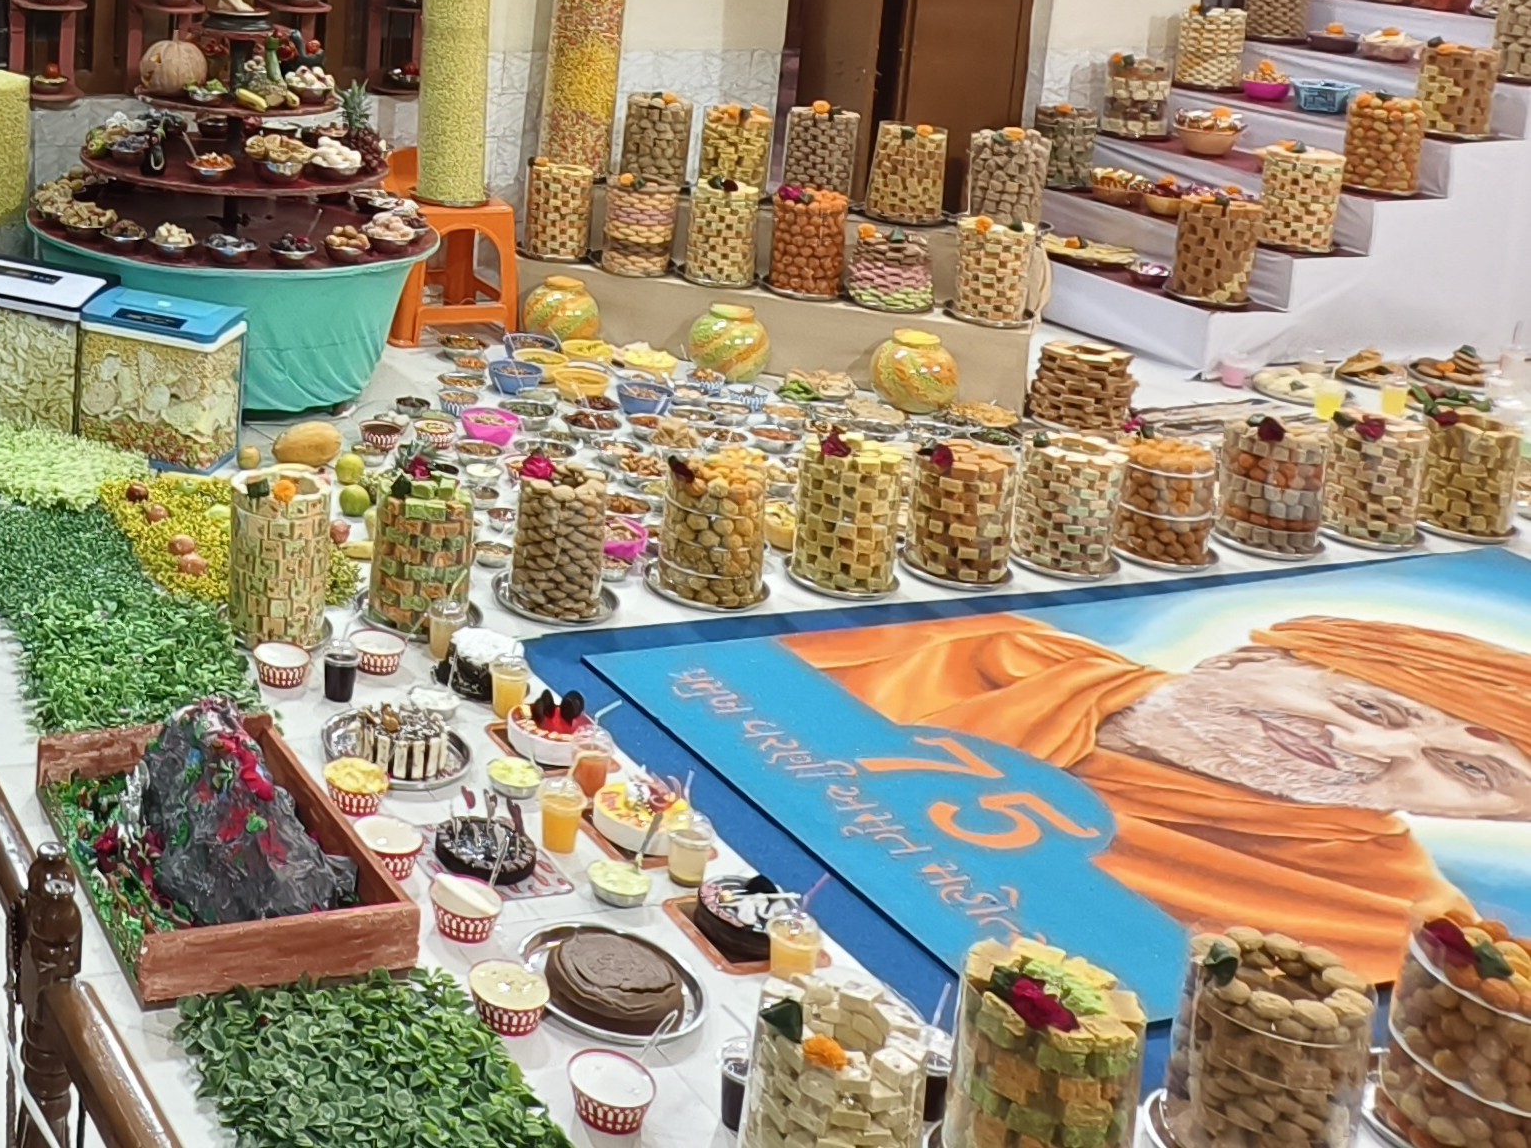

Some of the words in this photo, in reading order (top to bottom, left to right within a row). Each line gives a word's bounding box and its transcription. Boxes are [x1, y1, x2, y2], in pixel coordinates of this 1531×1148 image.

[743, 720, 857, 778] વરણી
[827, 784, 932, 856] અમૃત
[854, 736, 1101, 849] 75
